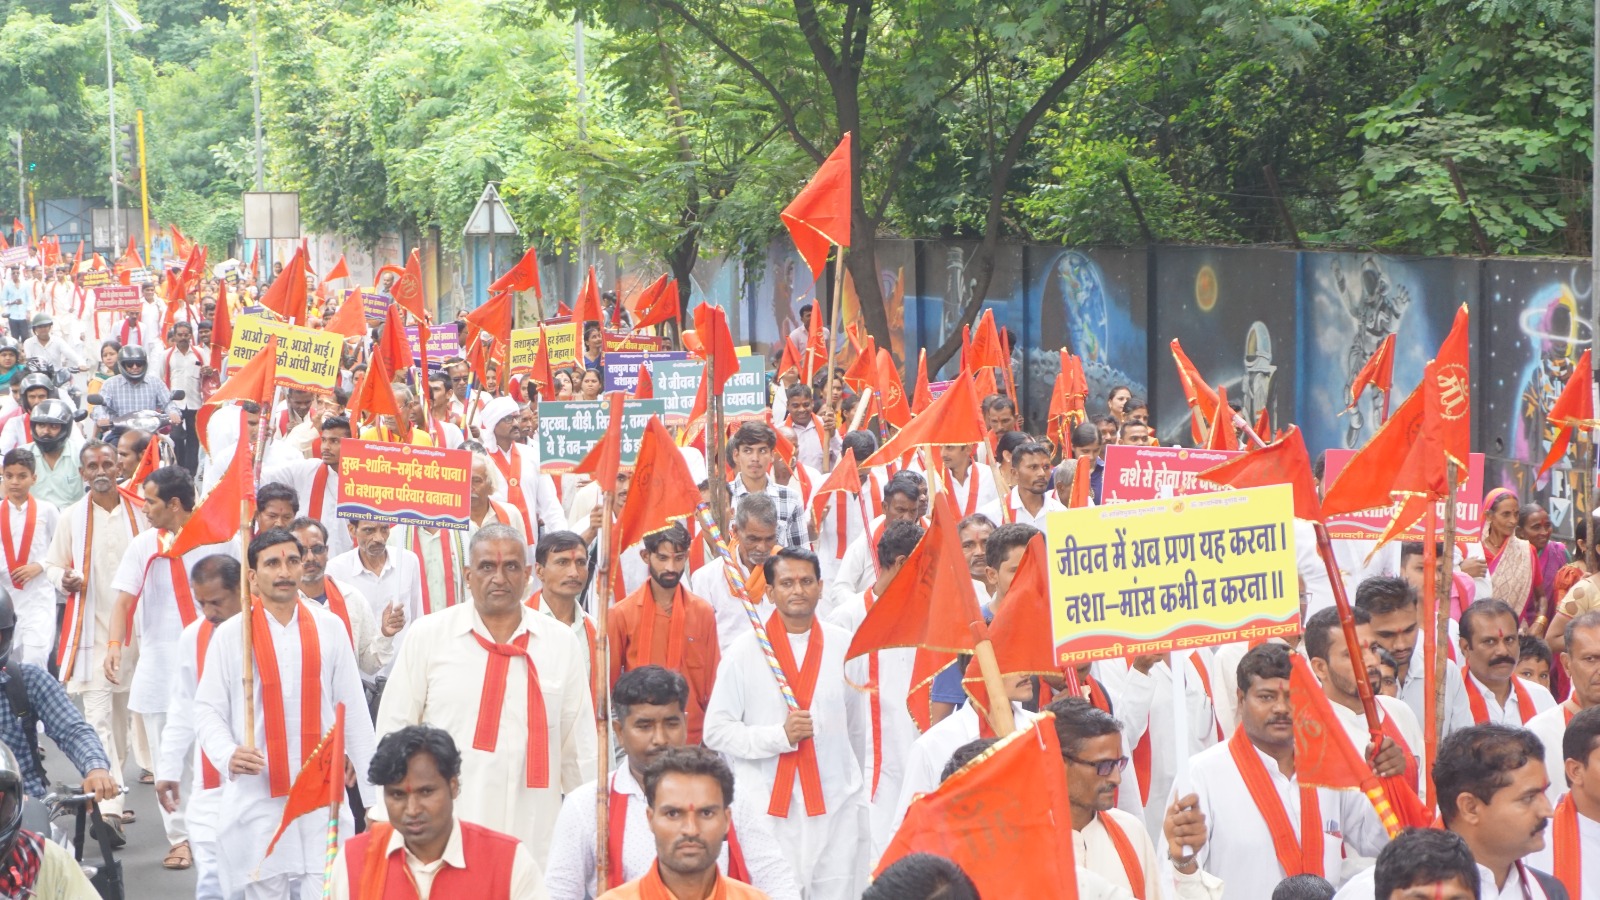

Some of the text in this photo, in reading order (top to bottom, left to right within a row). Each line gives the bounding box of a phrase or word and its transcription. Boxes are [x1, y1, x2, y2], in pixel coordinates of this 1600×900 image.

[241, 327, 263, 343] आओ
[291, 337, 312, 353] आओ
[668, 372, 695, 390] जीवन
[424, 460, 440, 480] यदि
[1120, 460, 1141, 487] नशे
[1143, 461, 1153, 488] से
[344, 478, 355, 496] तो
[1056, 534, 1108, 577] जीवन
[1112, 527, 1127, 570] में
[1131, 536, 1160, 568] अब
[1164, 533, 1195, 566] प्रण
[1199, 529, 1226, 564] यह
[1159, 568, 1198, 613] कभी
[1202, 578, 1216, 607] न
[1060, 623, 1298, 663] भगवती मानव कल्याण संगठन
